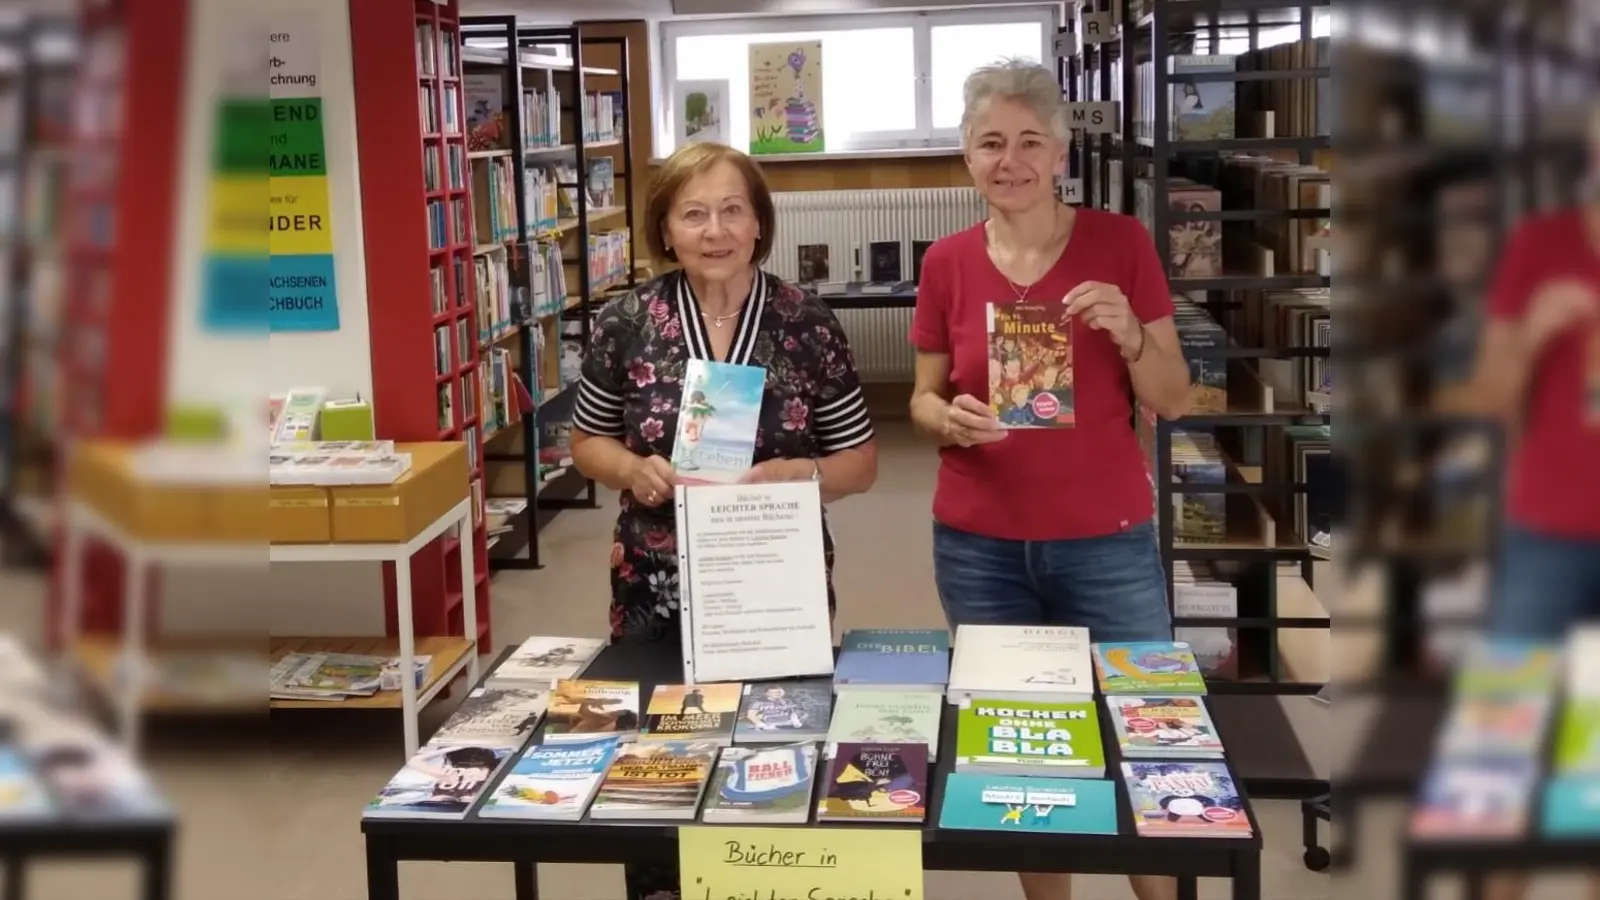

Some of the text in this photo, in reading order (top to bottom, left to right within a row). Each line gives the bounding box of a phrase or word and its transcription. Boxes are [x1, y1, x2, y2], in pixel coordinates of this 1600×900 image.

[1087, 20, 1100, 34] R
[1055, 40, 1063, 51] F
[270, 73, 316, 87] chnung
[1072, 109, 1085, 121] M
[1091, 109, 1104, 125] S
[1065, 186, 1076, 197] H
[1004, 321, 1056, 334] Minute
[710, 502, 800, 514] LEICHTER SPRACHE
[881, 644, 937, 653] BIBEL
[975, 707, 1087, 720] KOCHEN
[999, 719, 1056, 729] OHNE
[989, 726, 1072, 741] BLA
[989, 740, 1074, 756] BLA
[724, 840, 837, 866] Bücher in
